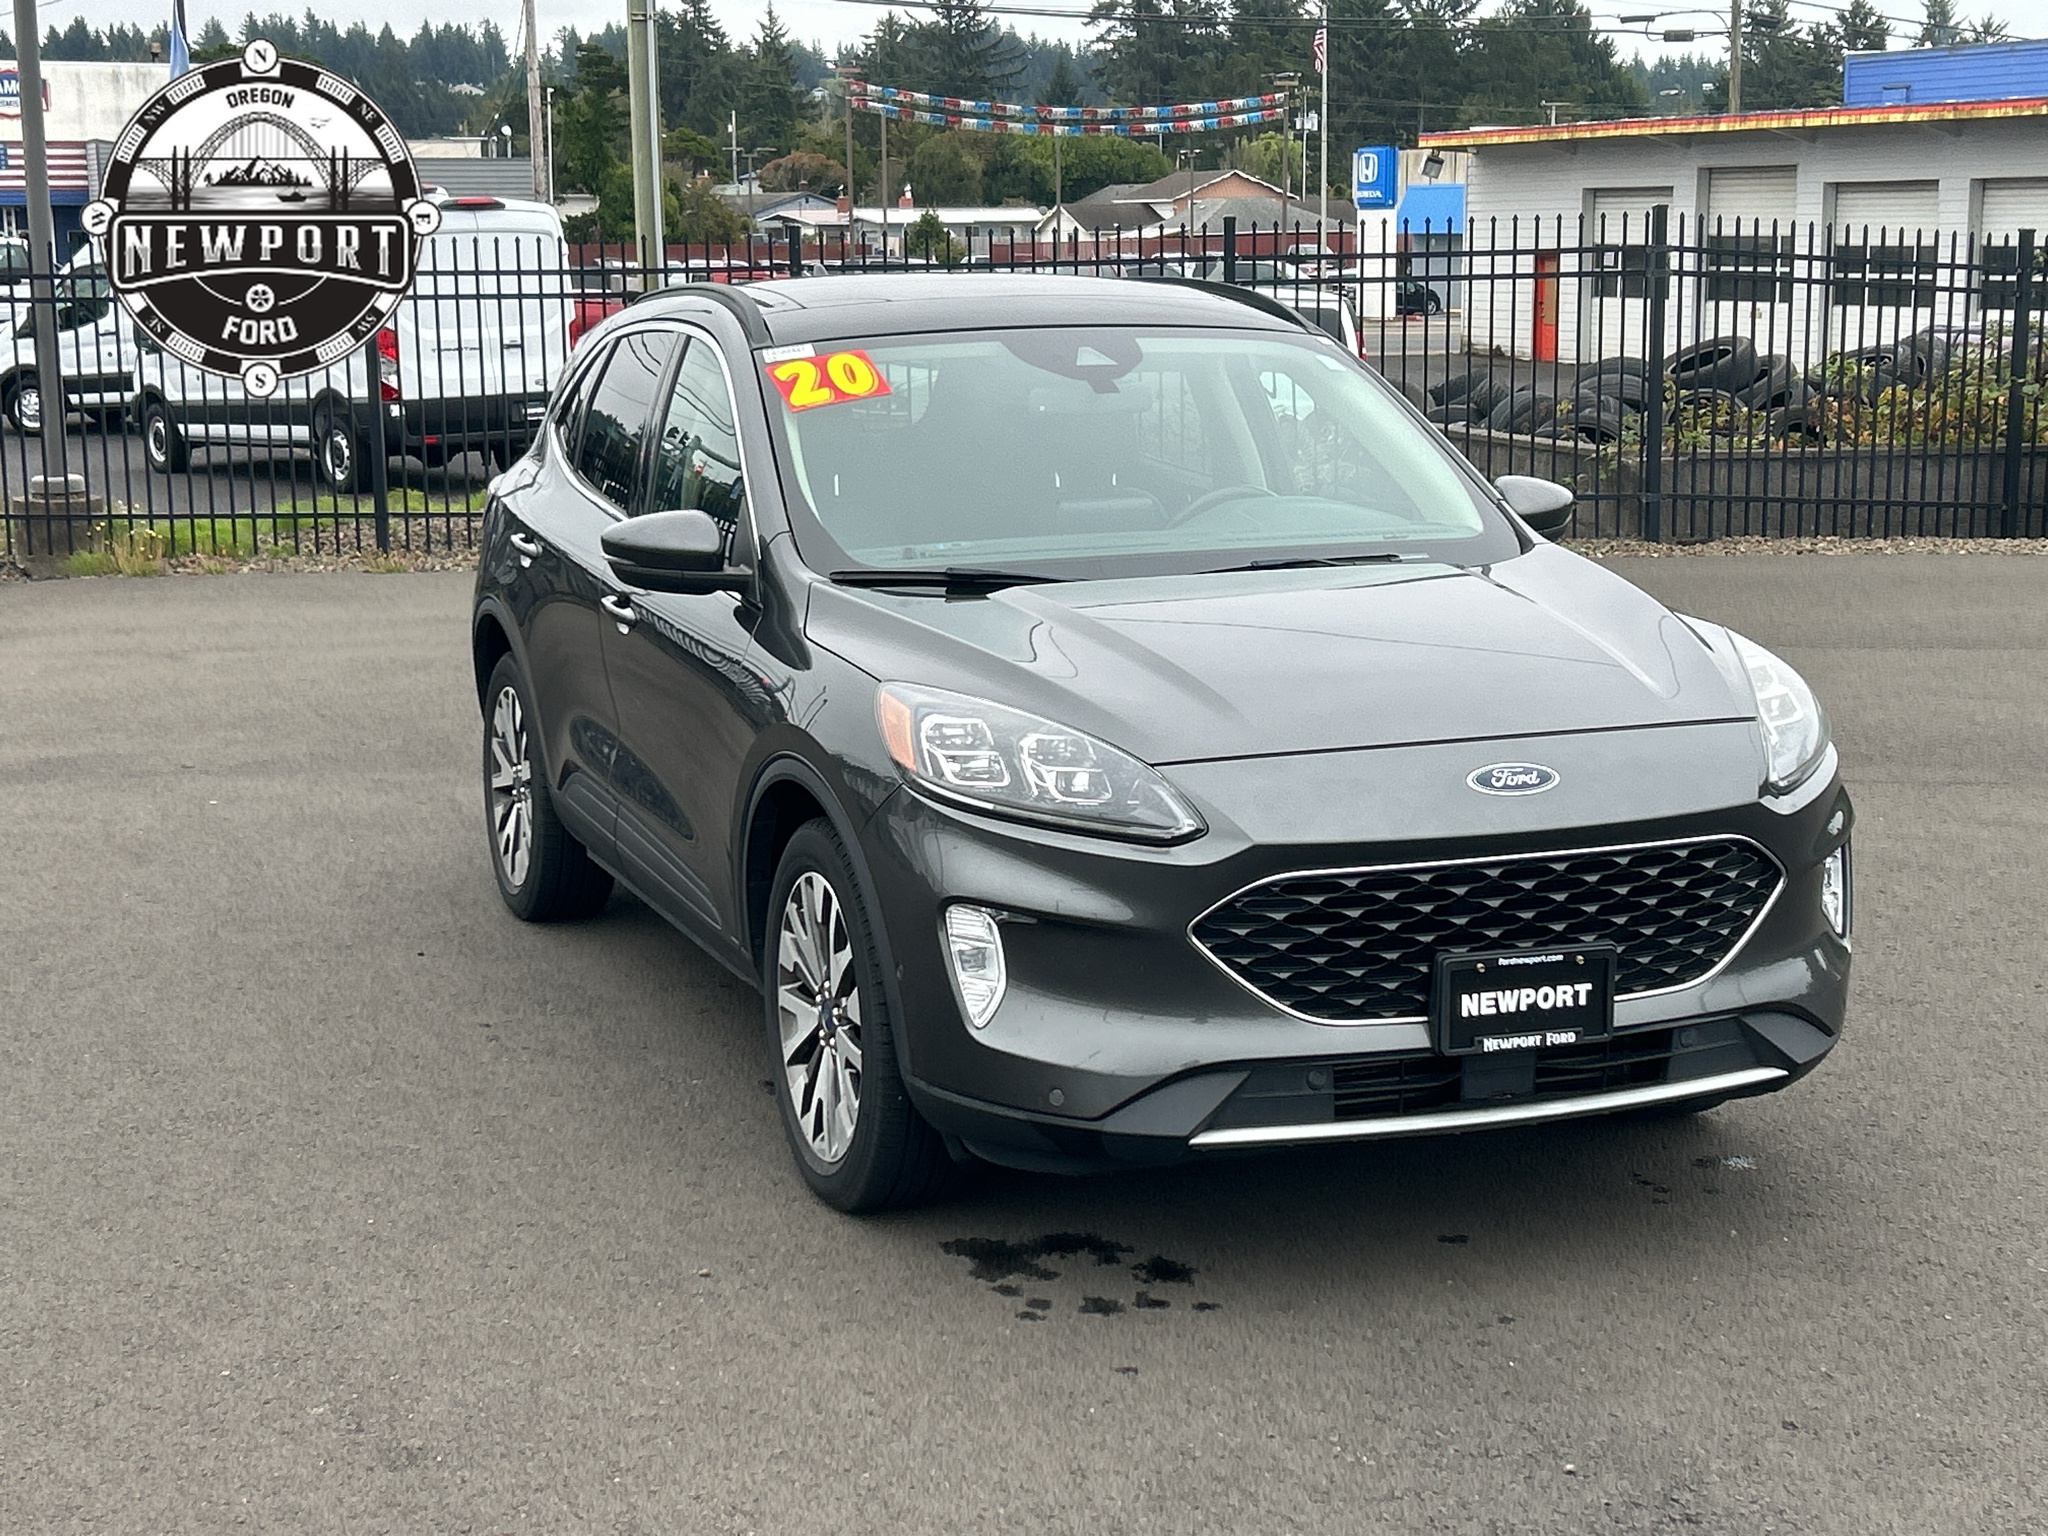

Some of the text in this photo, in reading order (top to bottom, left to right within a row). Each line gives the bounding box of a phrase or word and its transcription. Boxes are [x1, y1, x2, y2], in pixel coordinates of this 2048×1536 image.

[774, 353, 878, 407] 20
[1491, 767, 1540, 788] Ford
[1461, 983, 1593, 1017] NEWPORT
